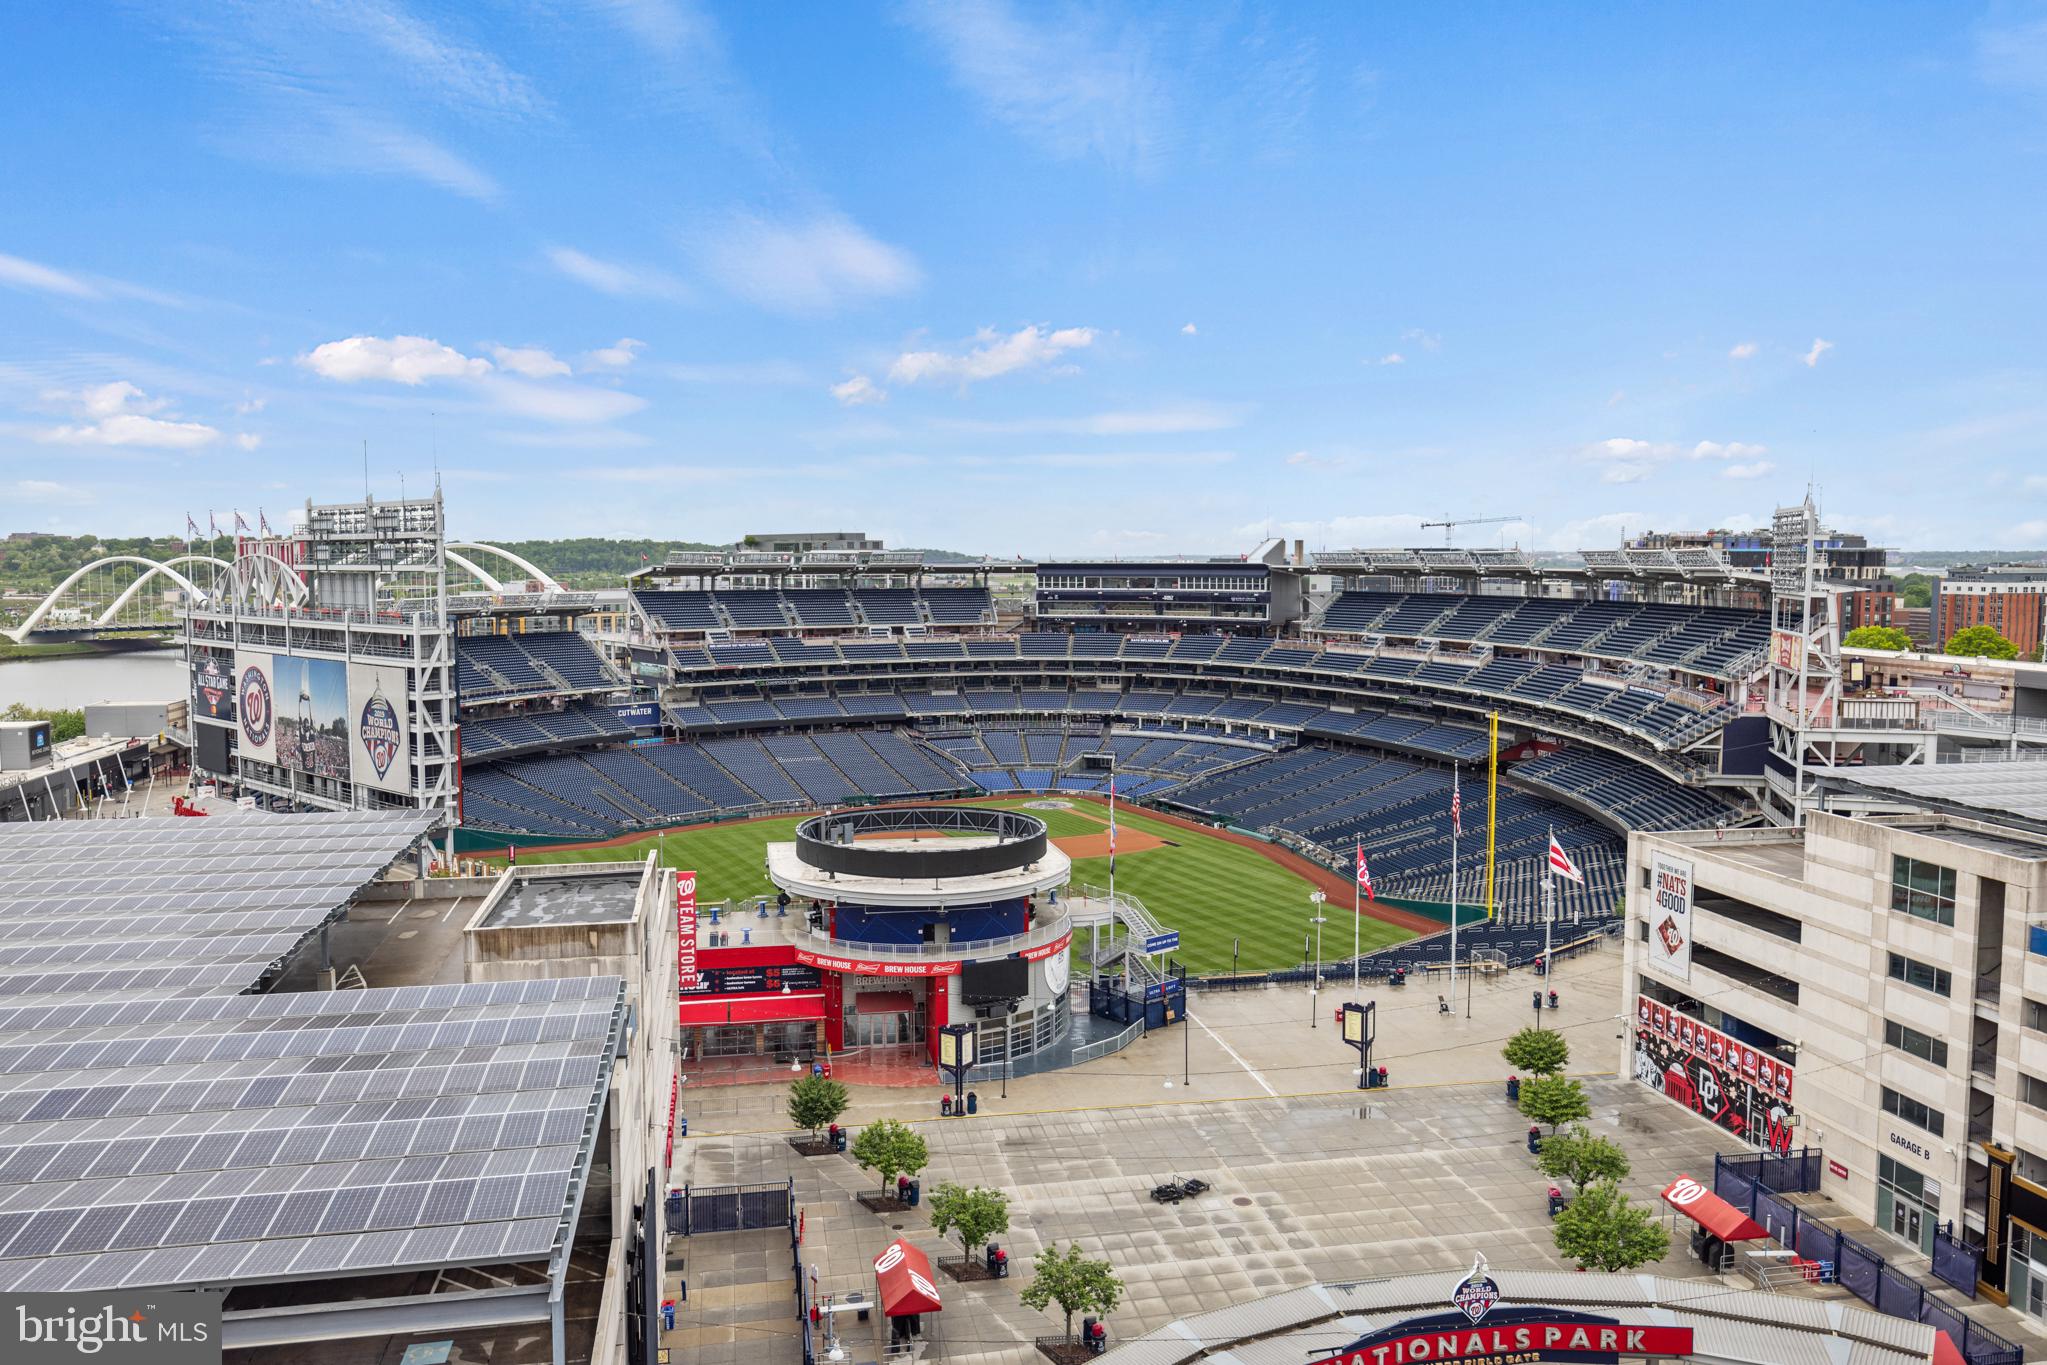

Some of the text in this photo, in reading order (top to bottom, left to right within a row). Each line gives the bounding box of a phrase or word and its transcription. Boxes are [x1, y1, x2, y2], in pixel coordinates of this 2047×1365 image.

[206, 674, 217, 688] STAR
[241, 668, 270, 701] WASHINGTON
[618, 707, 652, 717] CUTWATER
[367, 713, 393, 729] WORLD
[244, 717, 270, 743] NATIONALS
[362, 726, 399, 744] CHAMPIONS
[1658, 862, 1673, 873] TOGETHER
[1657, 871, 1686, 897] #NATS
[1656, 889, 1685, 915] 4GOOD
[680, 898, 695, 983] TEAM STORE
[817, 957, 852, 970] BREW HOUSE
[884, 965, 927, 974] BREW HOUSE
[766, 968, 780, 976] $5
[766, 980, 780, 988] $6
[856, 976, 881, 986] BREW
[1699, 1066, 1719, 1113] DC
[1890, 1132, 1930, 1160] GARAGE B
[1462, 1285, 1492, 1294] WORLD
[1455, 1291, 1498, 1303] CHAMPIONS
[1323, 1327, 1646, 1365] ATIONALS PARK
[1506, 1352, 1540, 1363] GATE
